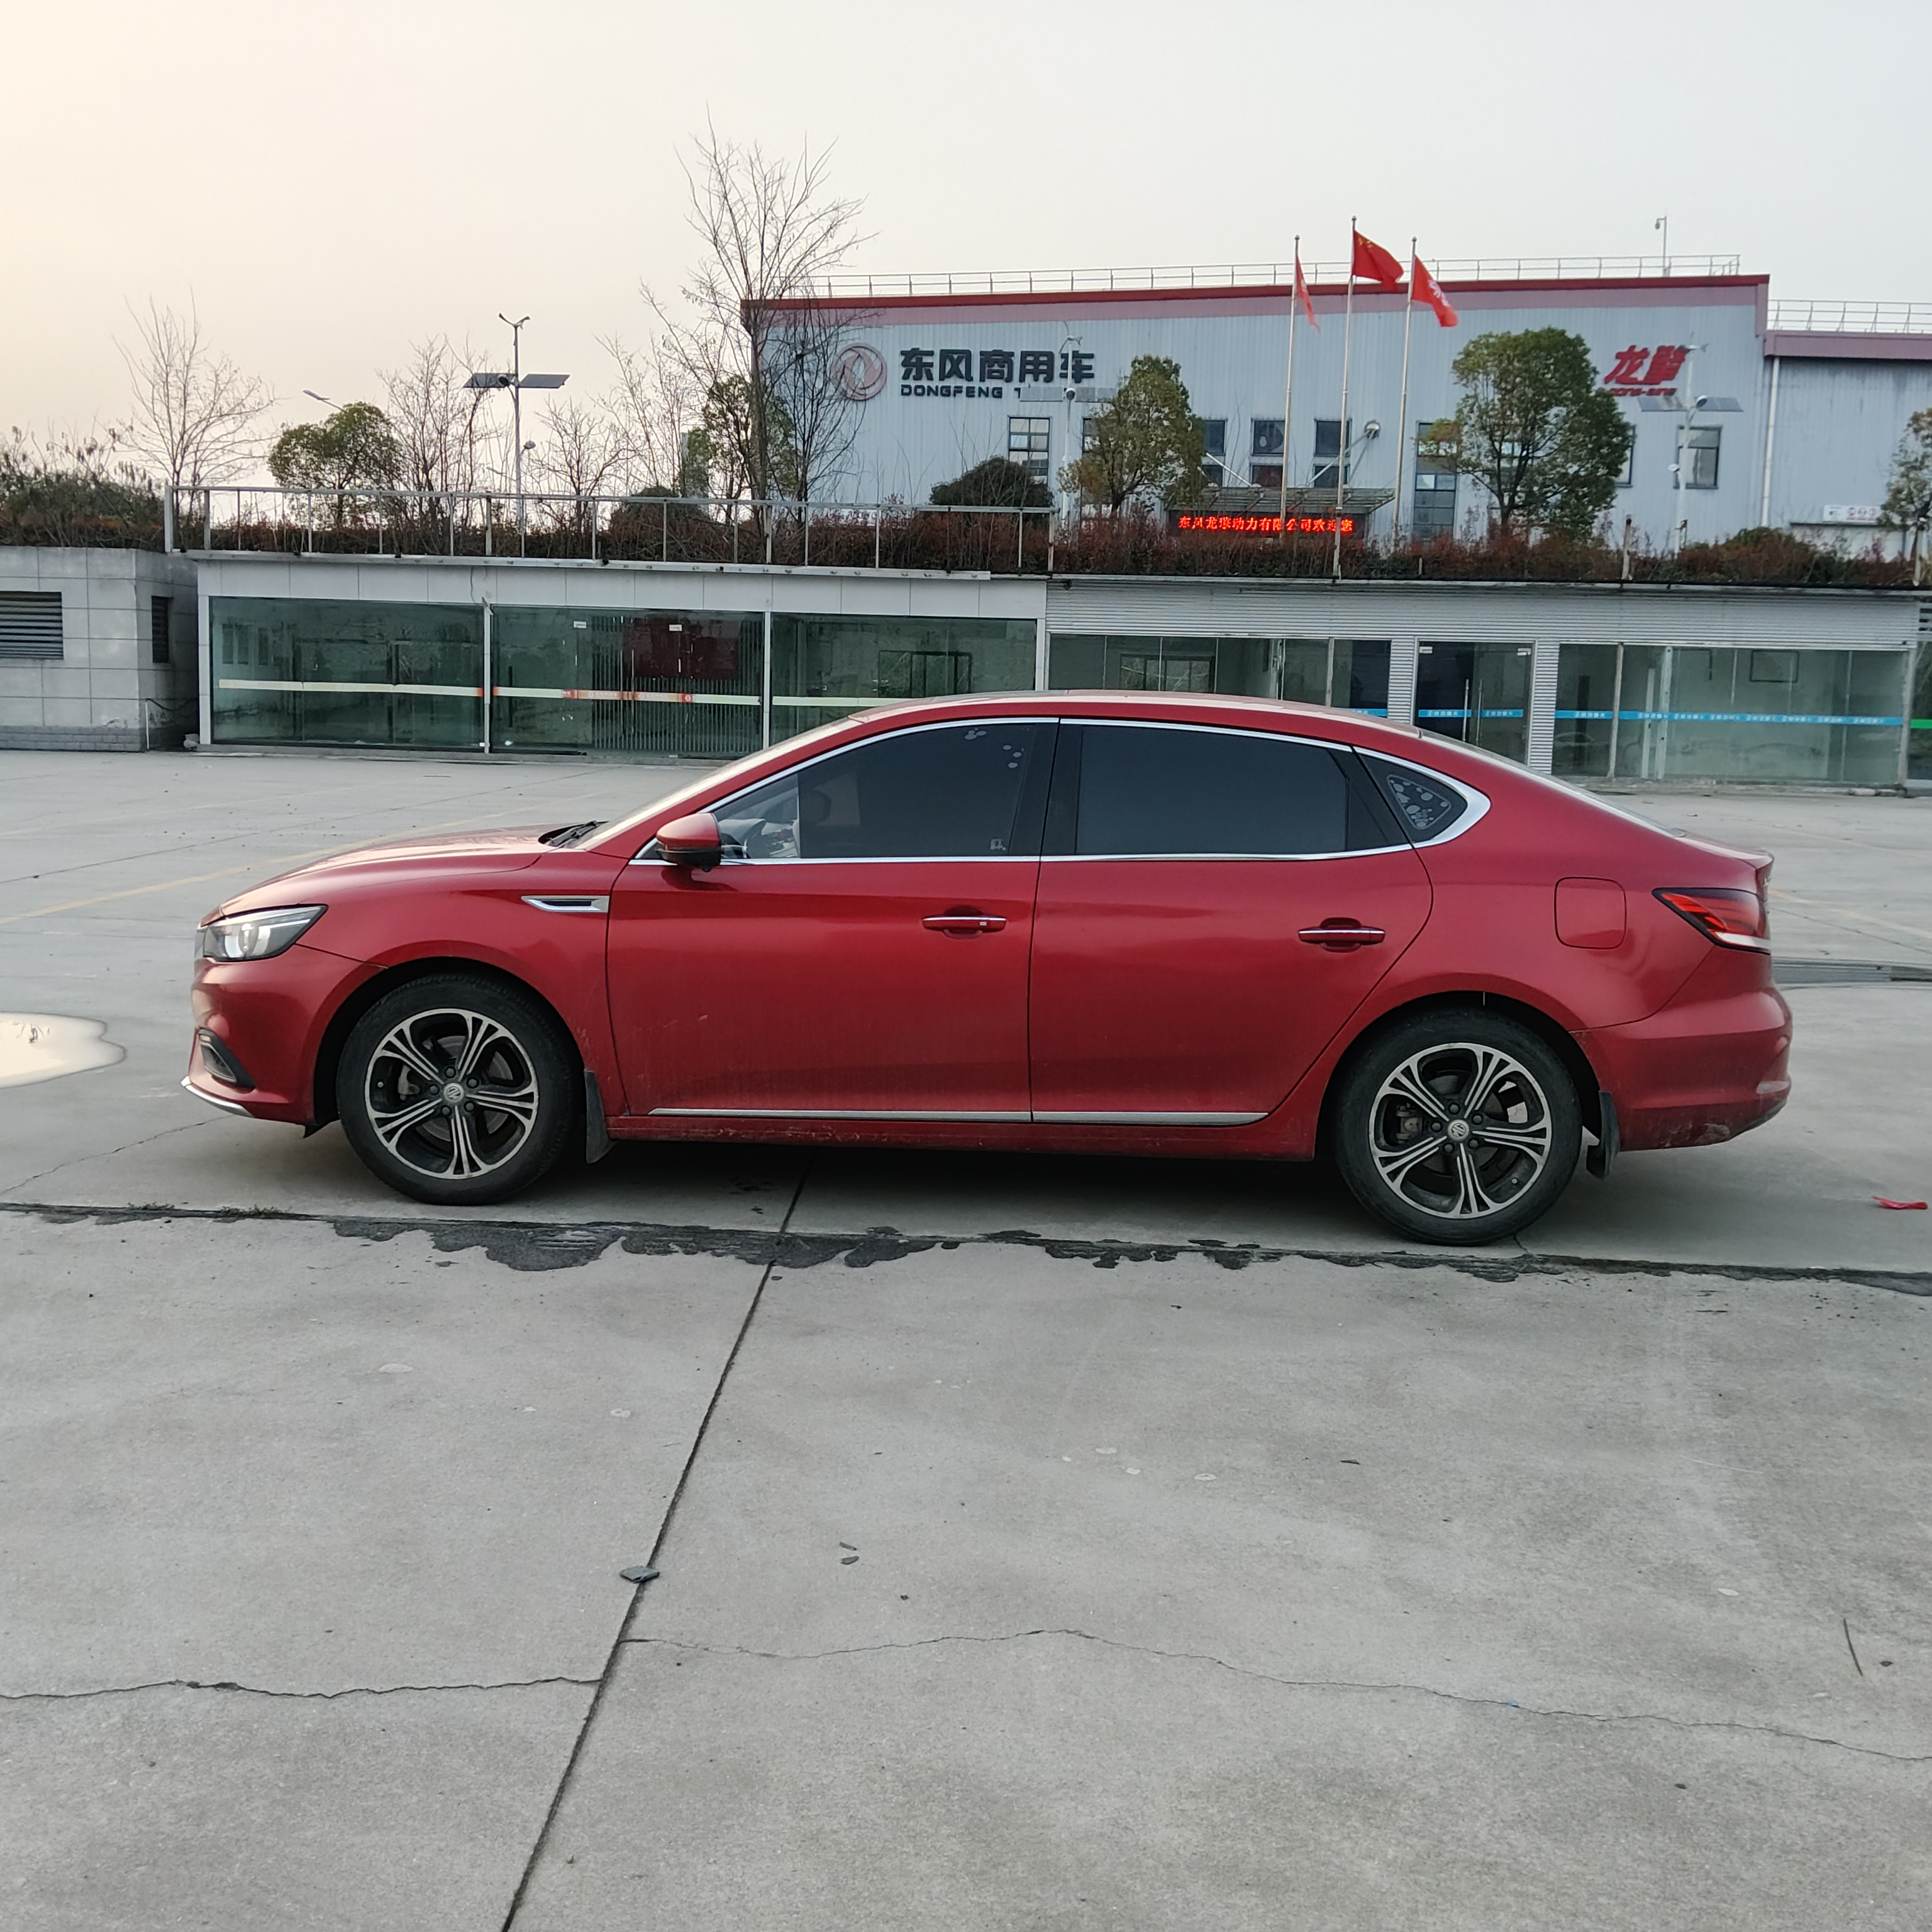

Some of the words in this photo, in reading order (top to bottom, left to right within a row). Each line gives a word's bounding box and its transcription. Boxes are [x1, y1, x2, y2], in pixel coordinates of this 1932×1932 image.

[901, 348, 1094, 384] 东风商用车
[901, 384, 1003, 399] DONGFENG
